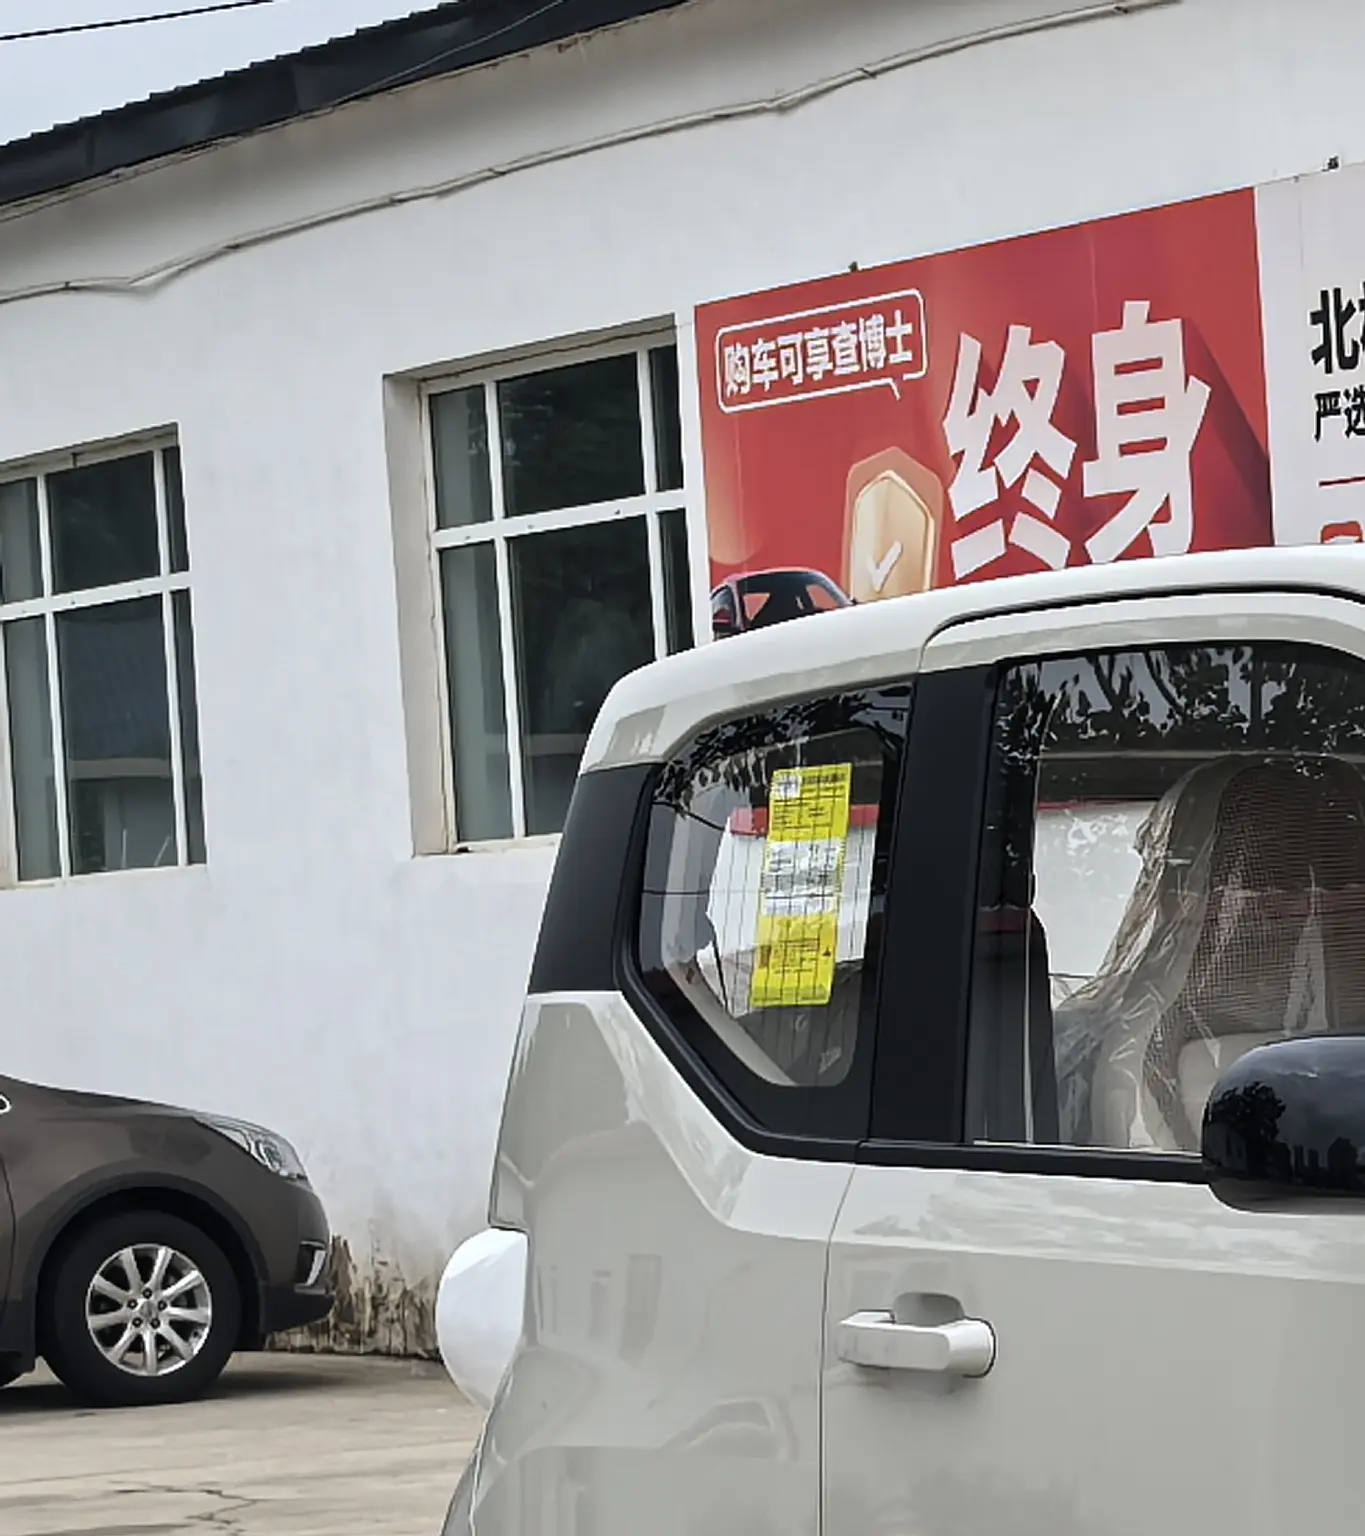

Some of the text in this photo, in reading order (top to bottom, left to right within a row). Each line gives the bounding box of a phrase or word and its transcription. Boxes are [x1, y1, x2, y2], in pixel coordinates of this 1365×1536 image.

[724, 309, 912, 397] 购车可享查博士
[943, 300, 1211, 580] 终身
